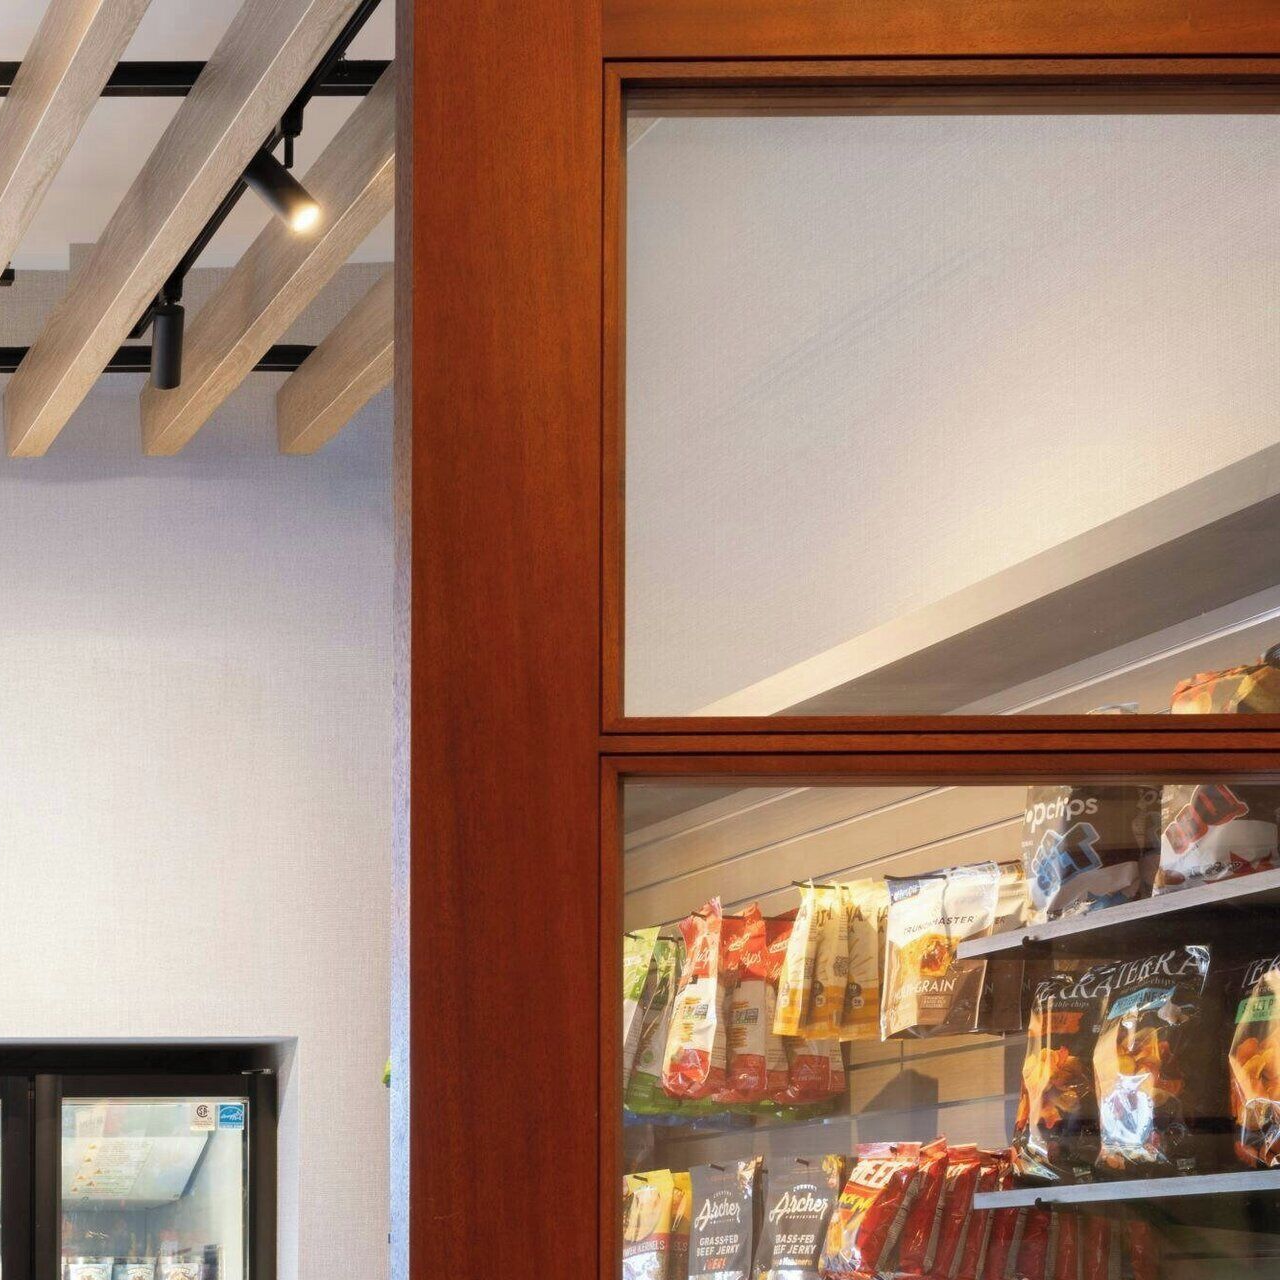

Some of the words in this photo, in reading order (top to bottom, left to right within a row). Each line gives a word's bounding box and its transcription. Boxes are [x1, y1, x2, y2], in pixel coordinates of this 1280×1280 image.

[1025, 795, 1098, 833] opchips
[694, 1198, 741, 1232] Archer
[769, 1191, 828, 1225] Archer
[696, 1246, 715, 1257] BEEF
[716, 1244, 739, 1256] JERKY
[699, 1234, 739, 1246] GRASS-FED
[788, 1244, 816, 1255] JERKY
